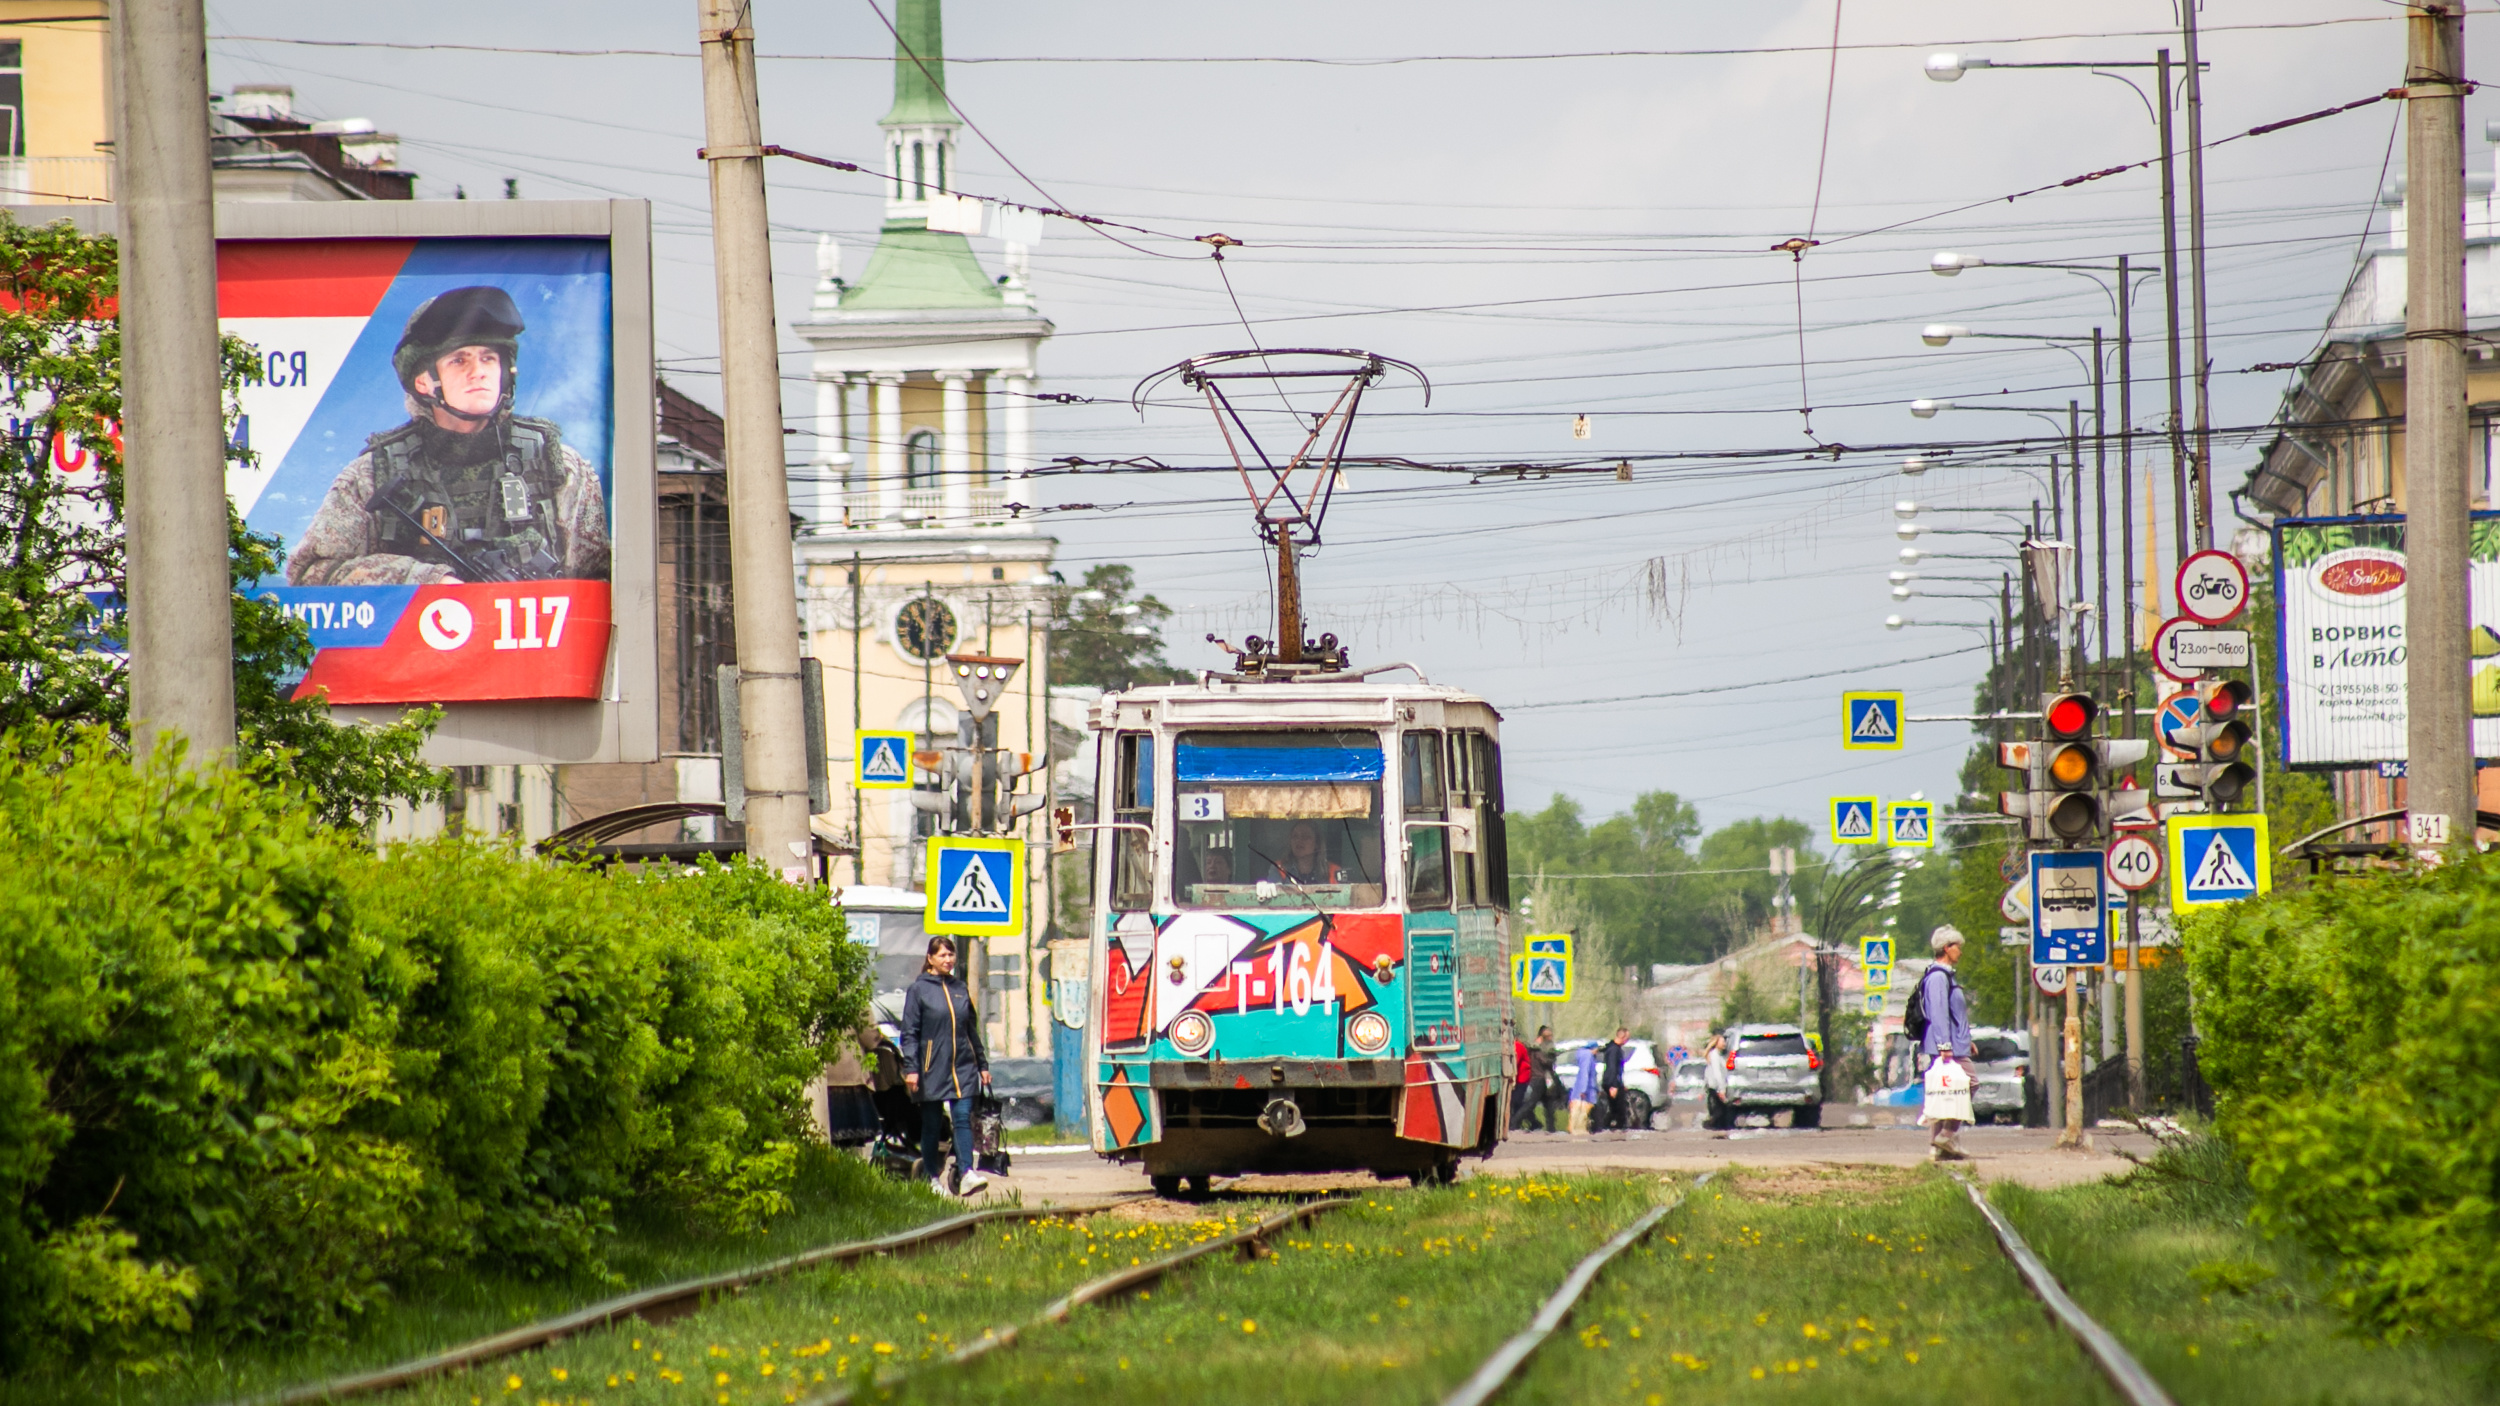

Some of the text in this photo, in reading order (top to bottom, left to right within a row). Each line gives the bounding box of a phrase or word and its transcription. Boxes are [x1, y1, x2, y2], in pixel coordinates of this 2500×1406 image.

[493, 596, 571, 650] 117
[2312, 624, 2404, 642] ВОРВИС
[1194, 797, 1210, 818] 3
[2417, 816, 2442, 839] 341
[2117, 851, 2151, 873] 40
[846, 919, 876, 940] 28
[1231, 940, 1336, 1017] Т-164
[2041, 968, 2065, 984] 40
